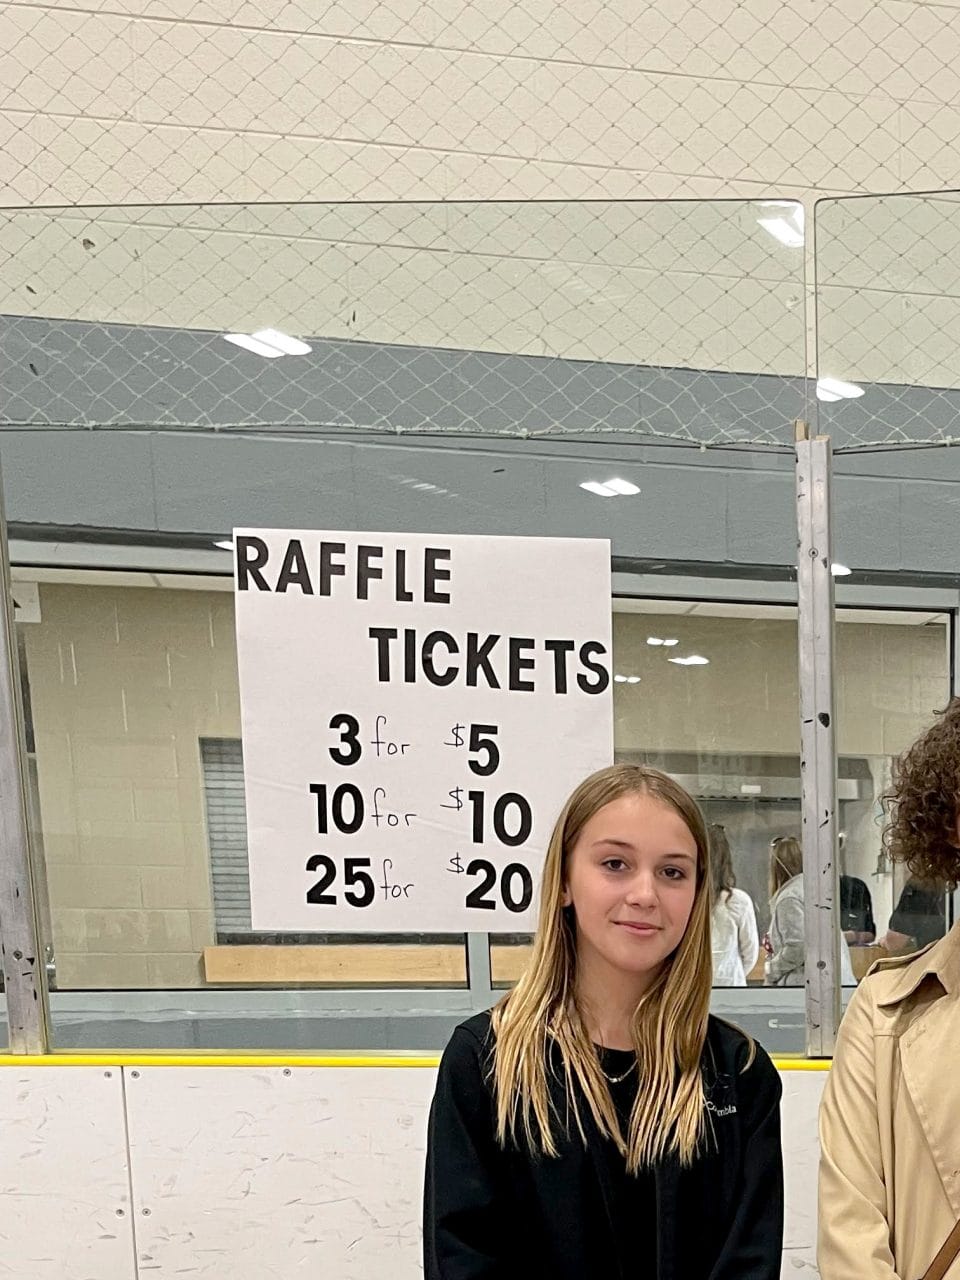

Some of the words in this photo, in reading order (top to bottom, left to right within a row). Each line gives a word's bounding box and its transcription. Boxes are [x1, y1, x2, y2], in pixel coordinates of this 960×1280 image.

[236, 536, 451, 604] RAFFLE
[369, 627, 609, 694] TICKETS
[329, 714, 361, 765] 3
[371, 716, 410, 757] for
[444, 724, 500, 776] $5
[309, 784, 364, 834] 10
[371, 788, 417, 828] for
[440, 787, 532, 847] $10
[305, 855, 375, 908] 25
[381, 859, 414, 899] for
[446, 852, 533, 913] $20
